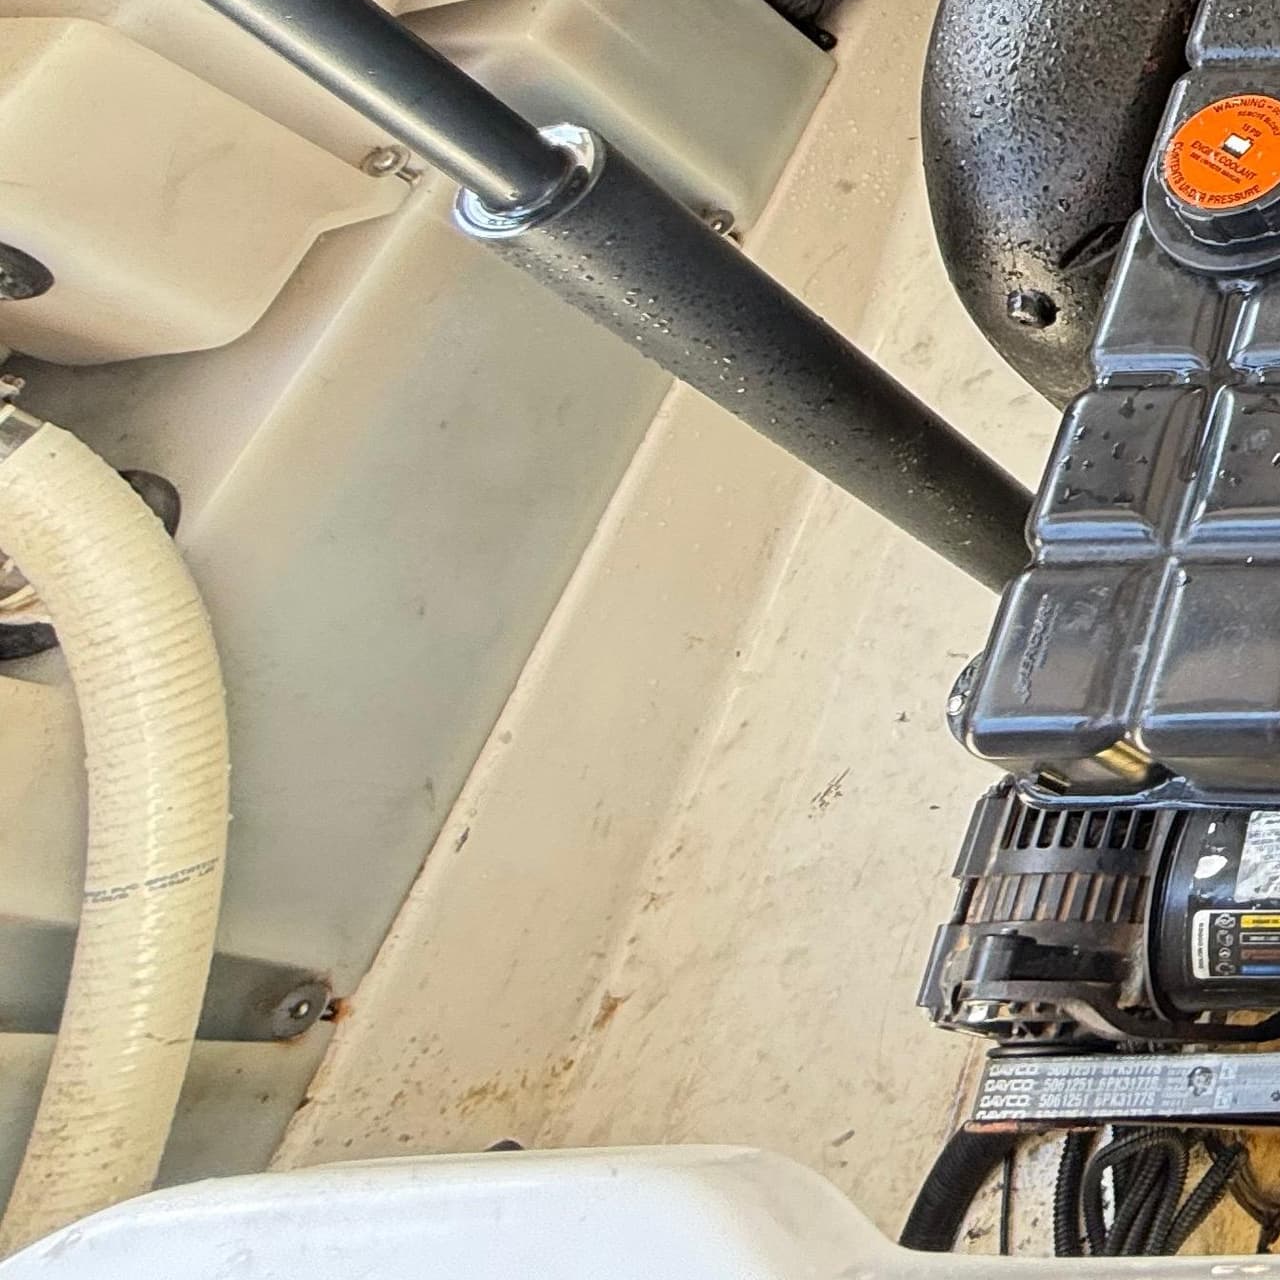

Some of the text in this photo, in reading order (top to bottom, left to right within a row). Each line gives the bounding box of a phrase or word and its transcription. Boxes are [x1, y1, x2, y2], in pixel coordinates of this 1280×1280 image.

[1213, 98, 1266, 112] WARNING
[1219, 156, 1256, 180] COOLANT
[1208, 184, 1261, 204] PRESSURE
[989, 1063, 1039, 1076] DAYCO
[984, 1078, 1034, 1092] DAYCO
[980, 1094, 1032, 1108] DAYCO
